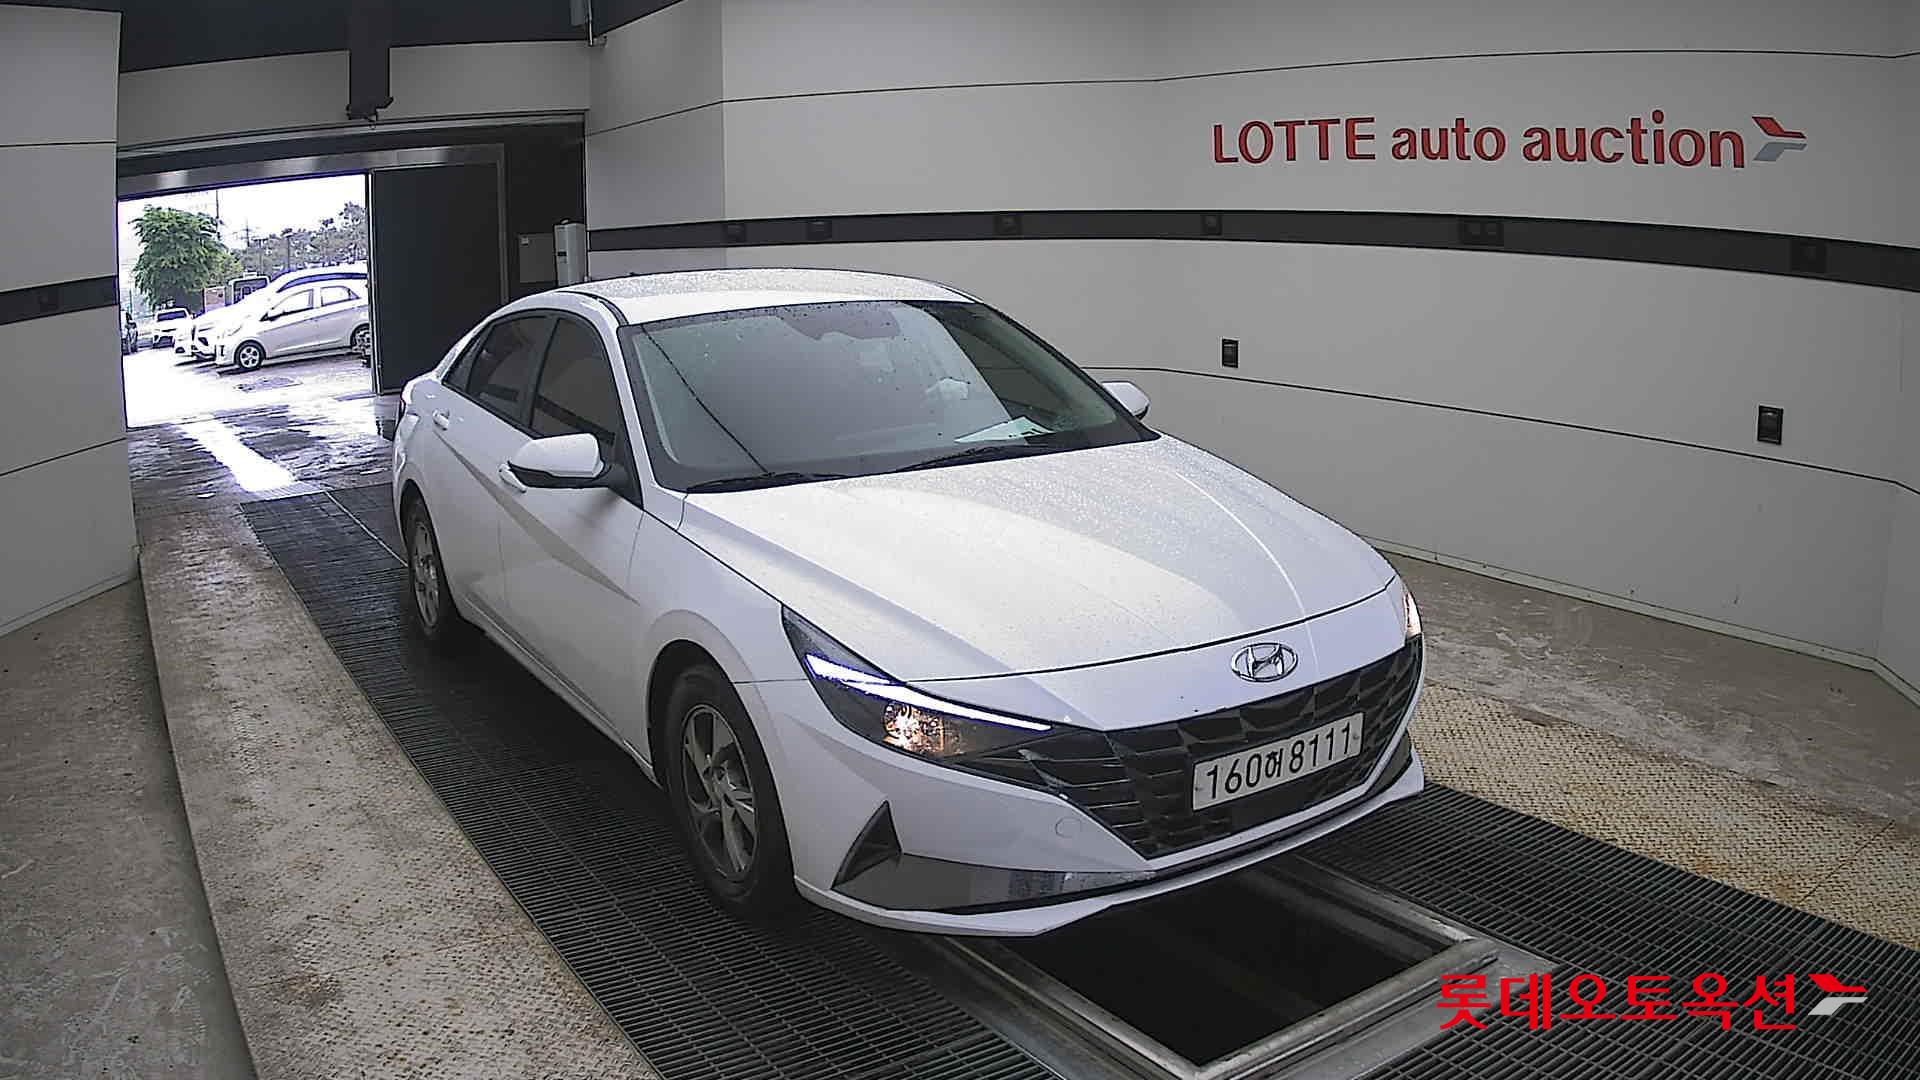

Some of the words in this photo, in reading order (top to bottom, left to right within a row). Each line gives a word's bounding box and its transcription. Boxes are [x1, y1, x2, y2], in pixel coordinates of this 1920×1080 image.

[1214, 117, 1376, 163] LOTTE
[1391, 118, 1507, 162] auto
[1522, 109, 1746, 168] auction
[1206, 721, 1351, 799] 160허8111
